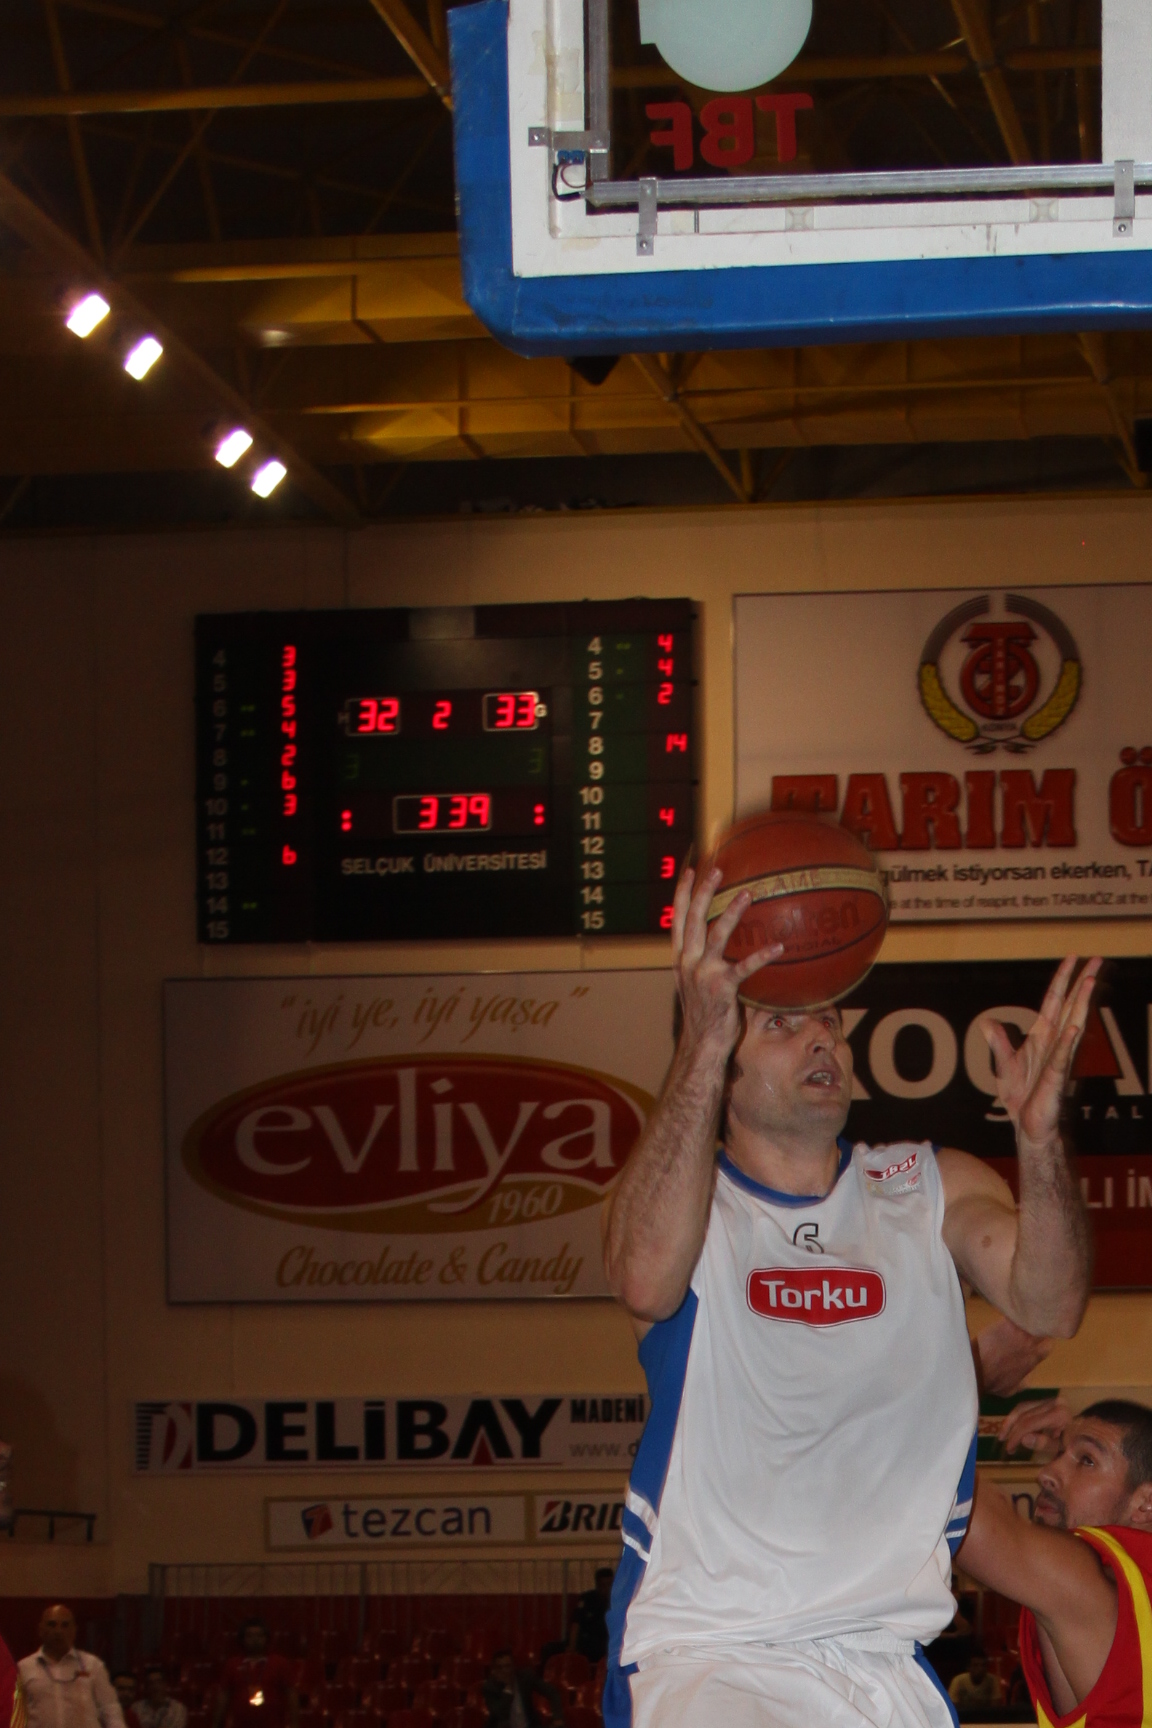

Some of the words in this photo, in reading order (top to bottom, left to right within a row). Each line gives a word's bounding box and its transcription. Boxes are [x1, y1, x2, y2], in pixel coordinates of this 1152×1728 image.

[587, 635, 603, 656] 4
[213, 647, 227, 668] 4
[588, 660, 603, 680] 5
[213, 672, 227, 693] 5
[587, 685, 604, 706] 6
[213, 697, 227, 718] 6
[356, 697, 400, 733] 32
[431, 699, 453, 731] 2
[494, 694, 535, 728] 33
[588, 710, 604, 730] 7
[214, 723, 227, 741] 7
[588, 735, 604, 756] 8
[213, 748, 228, 767] 8
[588, 760, 605, 780] 9
[213, 772, 228, 792] 9
[579, 784, 604, 806] 10
[206, 798, 228, 816] 10
[771, 768, 1076, 851] TARIM
[206, 821, 226, 841] 11
[580, 810, 602, 831] 11
[580, 834, 605, 855] 12
[206, 847, 228, 866] 12
[340, 856, 415, 877] SELÇUK
[580, 859, 605, 880] 13
[953, 860, 1045, 885] istiyorsan
[1050, 862, 1132, 882] ekerken,
[206, 871, 228, 891] 13
[207, 895, 228, 915] 14
[580, 884, 604, 905] 14
[206, 919, 229, 940] 15
[580, 909, 605, 930] 15
[413, 987, 466, 1043] iyi
[234, 1066, 617, 1214] evliya
[488, 1185, 563, 1225] 1960
[276, 1245, 434, 1289] Chocolate
[438, 1245, 467, 1284] &
[478, 1242, 584, 1294] Candy
[759, 1279, 867, 1311] Torku
[197, 1397, 563, 1465] DELİBAY
[343, 1503, 492, 1540] tezcan
